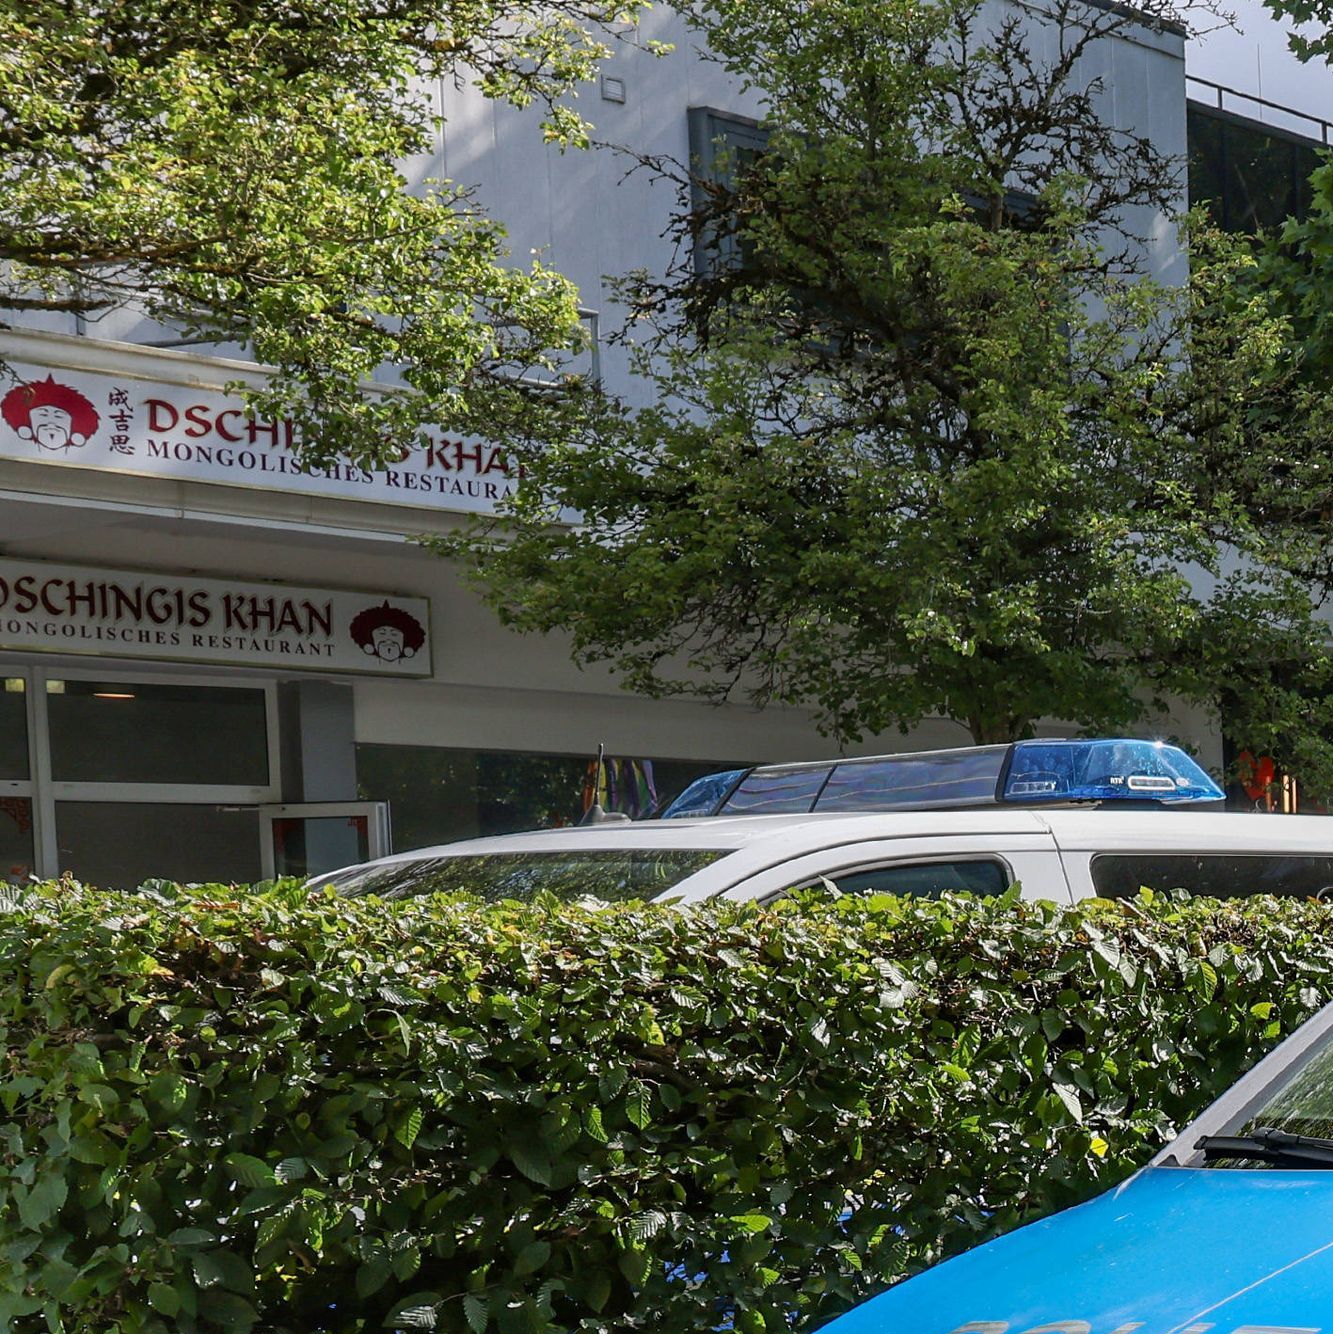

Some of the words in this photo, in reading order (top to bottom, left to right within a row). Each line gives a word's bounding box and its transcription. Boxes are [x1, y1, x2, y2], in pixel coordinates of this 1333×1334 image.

[108, 387, 135, 456] 成吉思
[142, 399, 410, 464] DSCHI
[426, 436, 526, 480] KHA
[0, 619, 180, 646] ONGOLISCHES
[192, 634, 336, 657] RESTAURANT
[222, 594, 333, 638] KHAN
